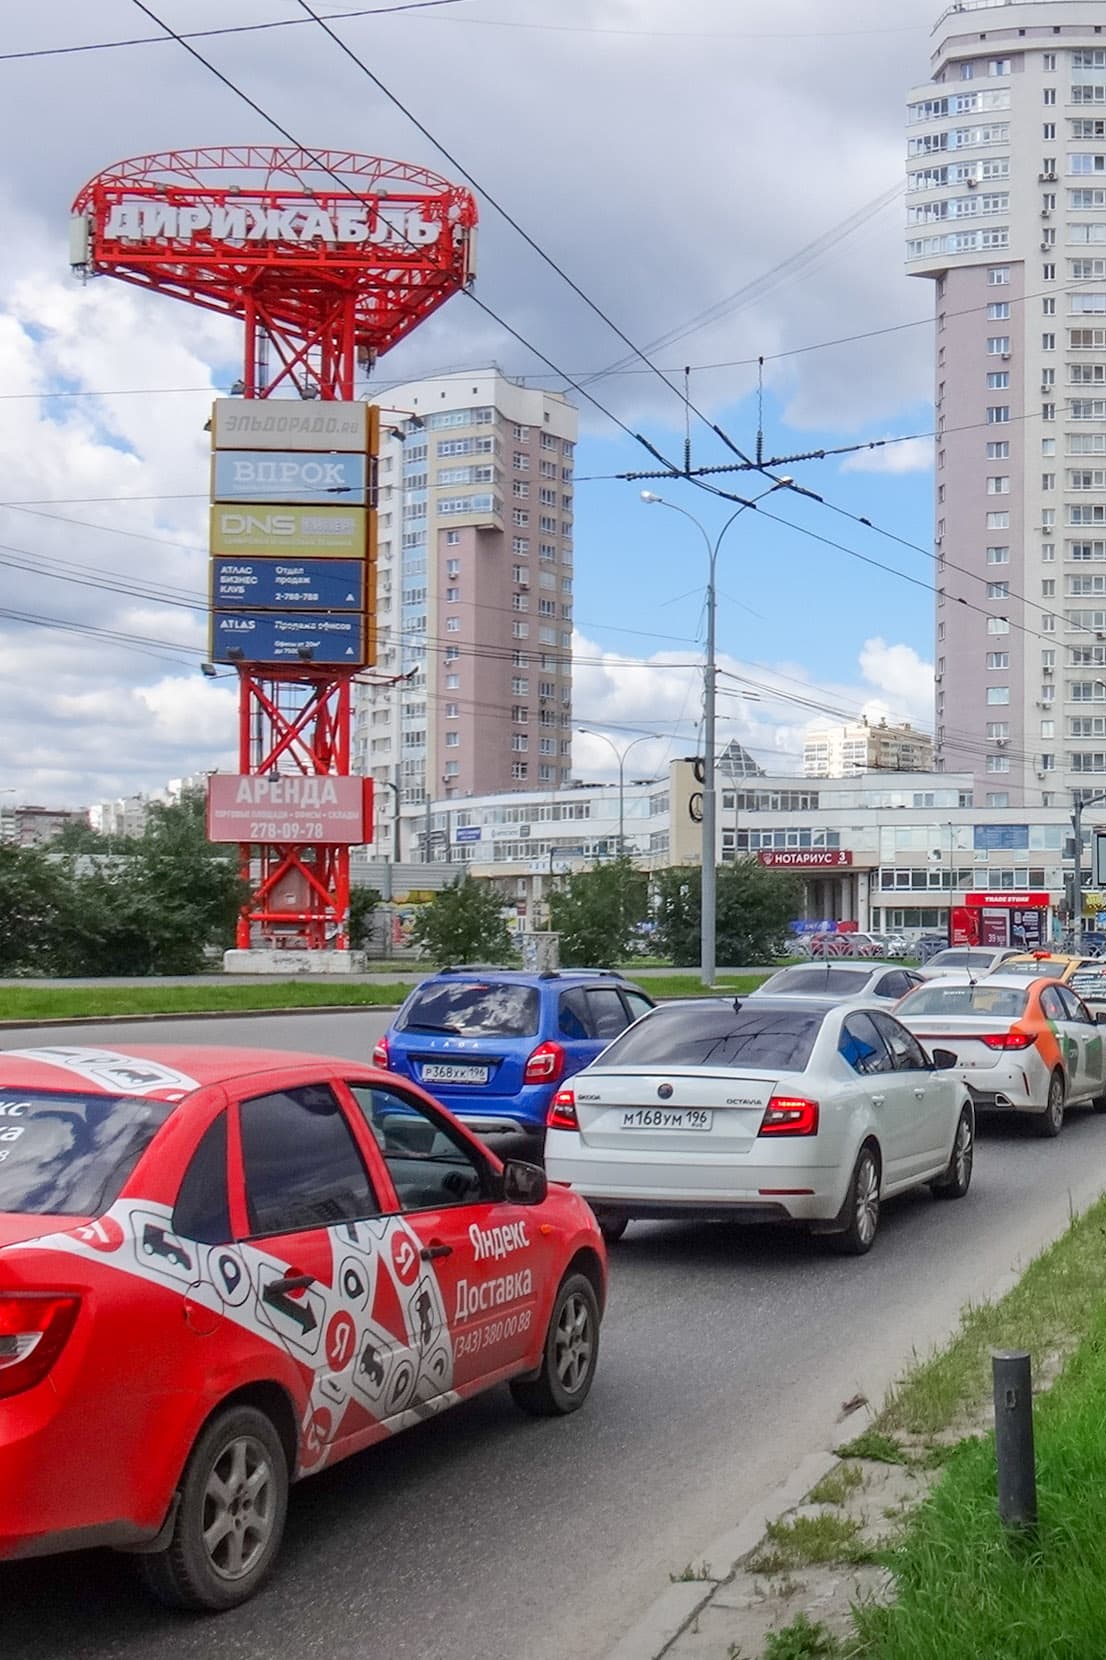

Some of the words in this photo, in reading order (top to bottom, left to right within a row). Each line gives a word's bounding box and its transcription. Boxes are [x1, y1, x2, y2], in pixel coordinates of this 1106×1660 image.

[104, 203, 441, 244] ДИРИЖАБЛЬ
[233, 460, 346, 483] ВПРОК
[220, 514, 296, 536] DNS
[220, 566, 253, 575] АТЛАС
[275, 566, 304, 576] Отдел
[220, 576, 258, 584] БИЗНЕС
[275, 577, 311, 585] продаж
[220, 585, 246, 594] КЛУБ
[220, 620, 256, 629] ATLAS
[274, 621, 316, 632] Продажа
[318, 622, 352, 632] офисов
[236, 778, 338, 808] АРЕНДА
[250, 822, 323, 839] 278-09-78
[775, 853, 832, 864] НОТАРИУС
[838, 851, 846, 861] 3
[430, 1040, 479, 1049] LADA
[469, 1066, 485, 1077] 196
[726, 1098, 762, 1106] OCTAVIA
[623, 1110, 683, 1127] М168УМ
[686, 1110, 708, 1123] 196
[468, 1220, 531, 1262] Яндекс
[453, 1268, 533, 1326] Доставка
[454, 1327, 482, 1360] (343)
[482, 1319, 503, 1349] 380
[503, 1315, 518, 1338] 00
[517, 1310, 532, 1334] 88
